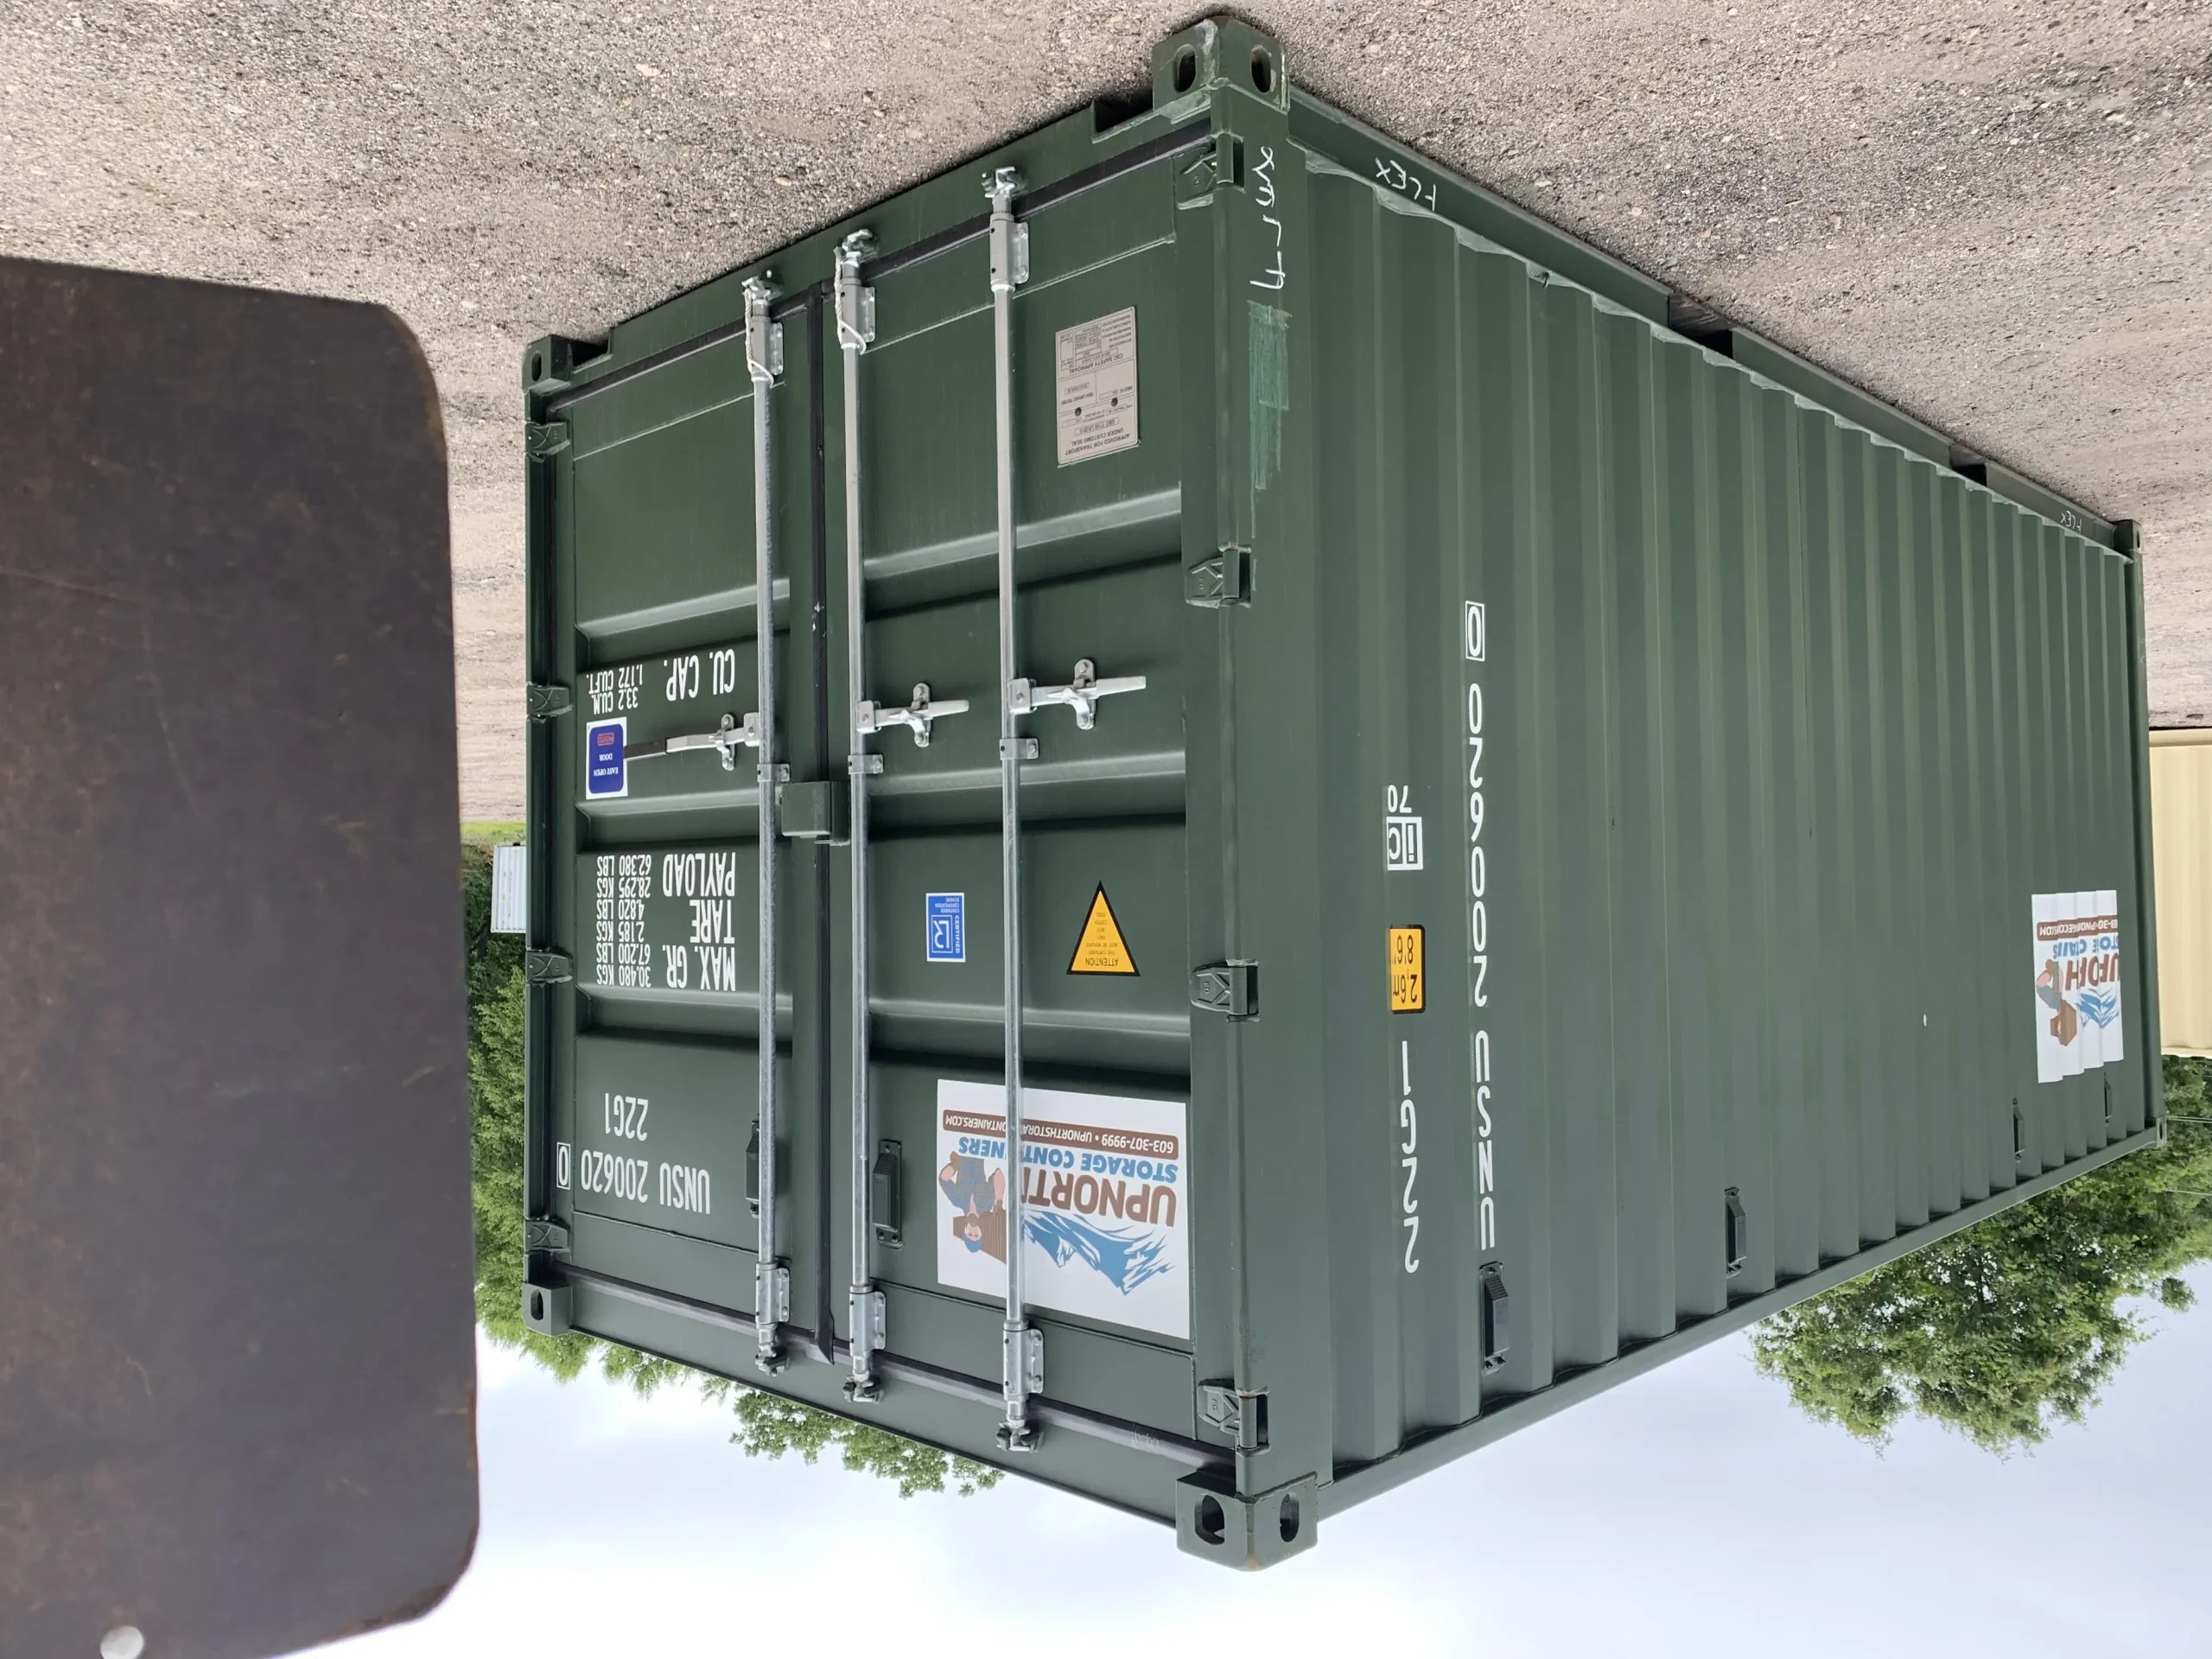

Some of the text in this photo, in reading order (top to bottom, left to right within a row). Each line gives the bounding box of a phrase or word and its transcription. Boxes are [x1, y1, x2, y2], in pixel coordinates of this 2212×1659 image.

[1374, 156, 1437, 213] FLEX
[1069, 363, 1094, 374] APPROVAL
[1094, 356, 1113, 366] SAFETY
[1083, 433, 1107, 443] CUSTOMS
[1104, 433, 1130, 445] APPROVED
[1107, 428, 1124, 436] UNDER
[1065, 443, 1093, 455] TRANSPORT
[2060, 510, 2082, 535] FLEX
[586, 664, 643, 695] 1,172 CU.FT.
[663, 648, 735, 702] CU. CAP.
[591, 686, 639, 715] 33.2 CU.M.
[599, 753, 613, 762] DOOR
[593, 766, 619, 777] EASY OPEN
[1387, 785, 1413, 814] 70
[1468, 683, 1488, 1007] 200620
[596, 855, 615, 877] LBS
[662, 852, 736, 897] PAYLOAD
[596, 876, 614, 899] KGS
[595, 899, 614, 920] LBS
[689, 899, 735, 944] TARE
[595, 920, 614, 942] KGS
[933, 920, 950, 949] LR
[595, 942, 614, 964] LBS
[1084, 957, 1119, 967] ATTENTION
[595, 963, 614, 986] KGS
[662, 944, 688, 989] GR.
[694, 945, 736, 992] MAX.
[604, 1092, 649, 1141] 22G1
[1101, 1134, 1174, 1154] 603-307-9999
[1474, 1029, 1495, 1250] UNSU
[957, 1136, 1179, 1184] STORAGE CONTNERS
[1400, 1039, 1420, 1274] 22G1
[557, 1144, 710, 1215] UNSU 200620 0
